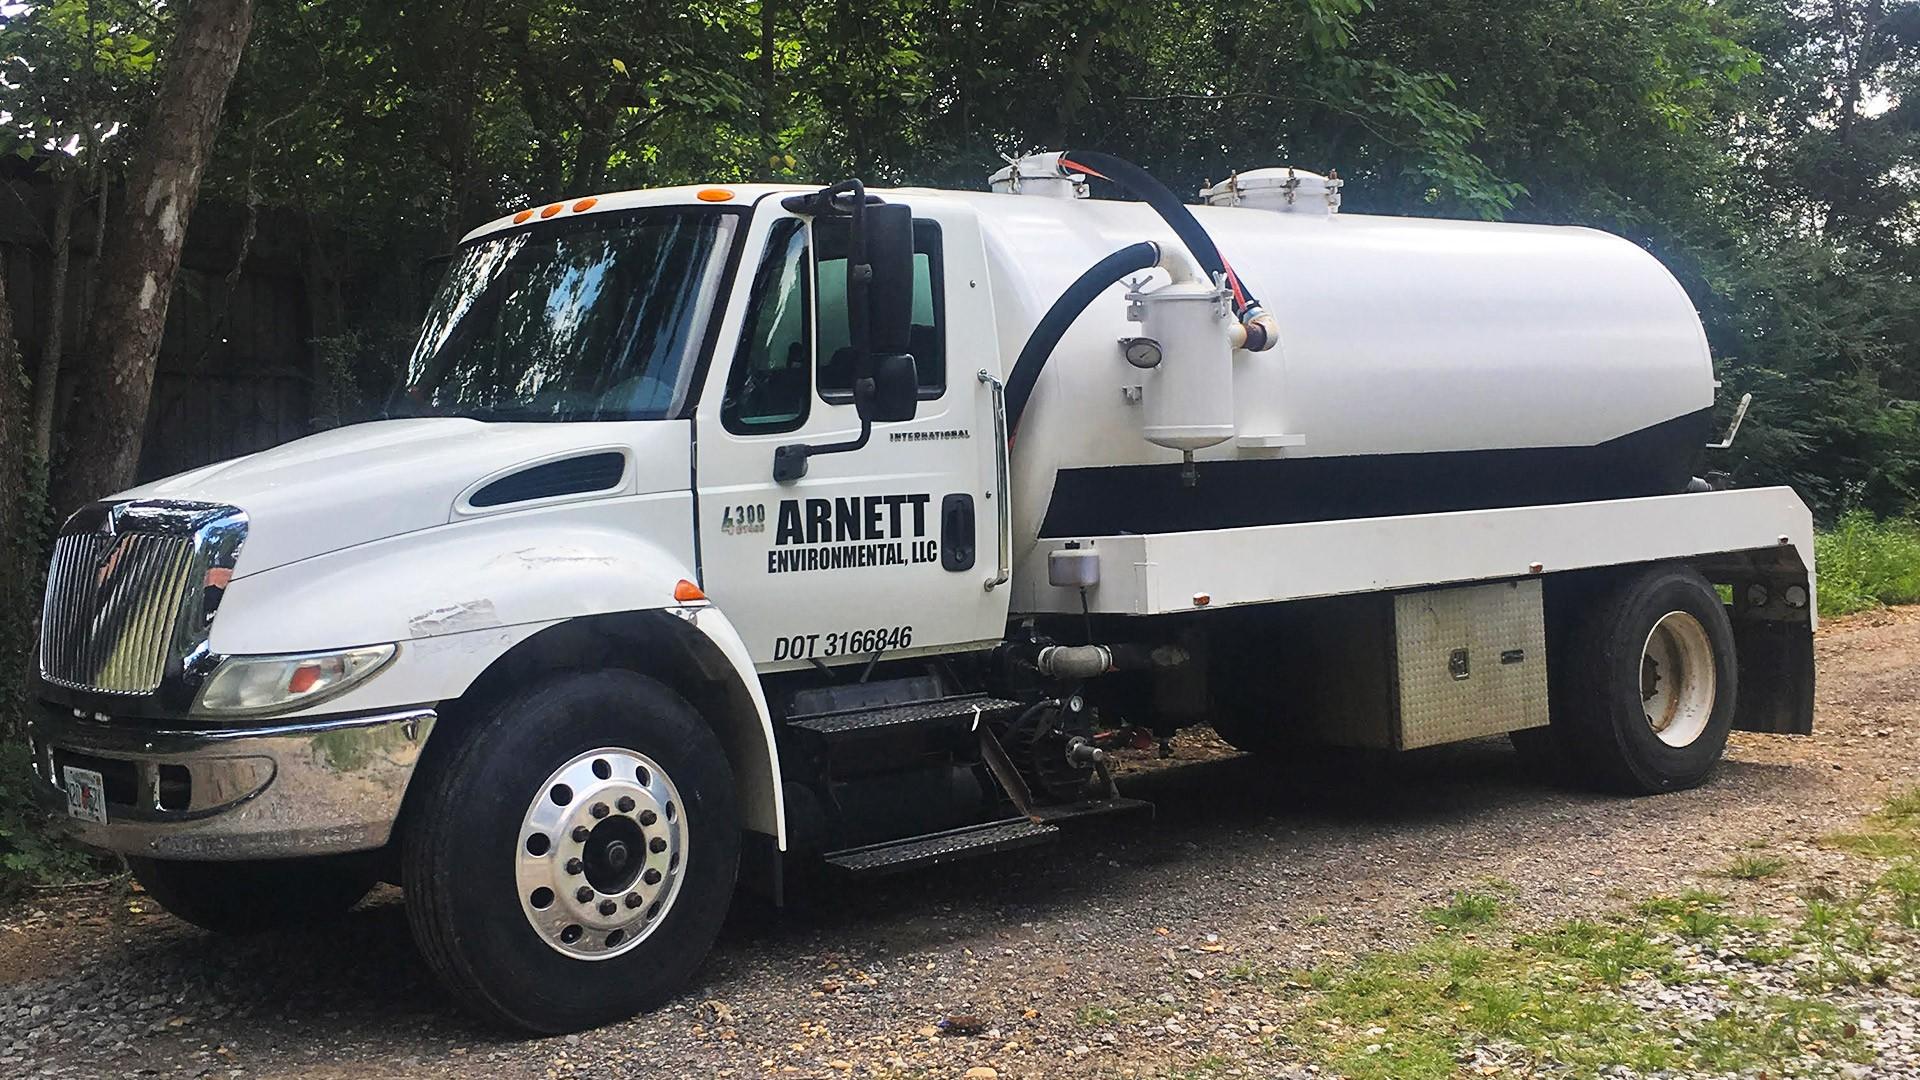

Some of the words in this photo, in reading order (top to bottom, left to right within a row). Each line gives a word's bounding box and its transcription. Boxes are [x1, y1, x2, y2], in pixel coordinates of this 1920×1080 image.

[889, 430, 970, 442] INTERNATIONAL
[721, 504, 766, 535] 4300
[775, 494, 930, 546] ARNETT
[768, 543, 909, 574] ENVIRONMENTAL,
[912, 540, 938, 564] LLC
[774, 634, 820, 661] DOT
[824, 626, 913, 656] 3166846
